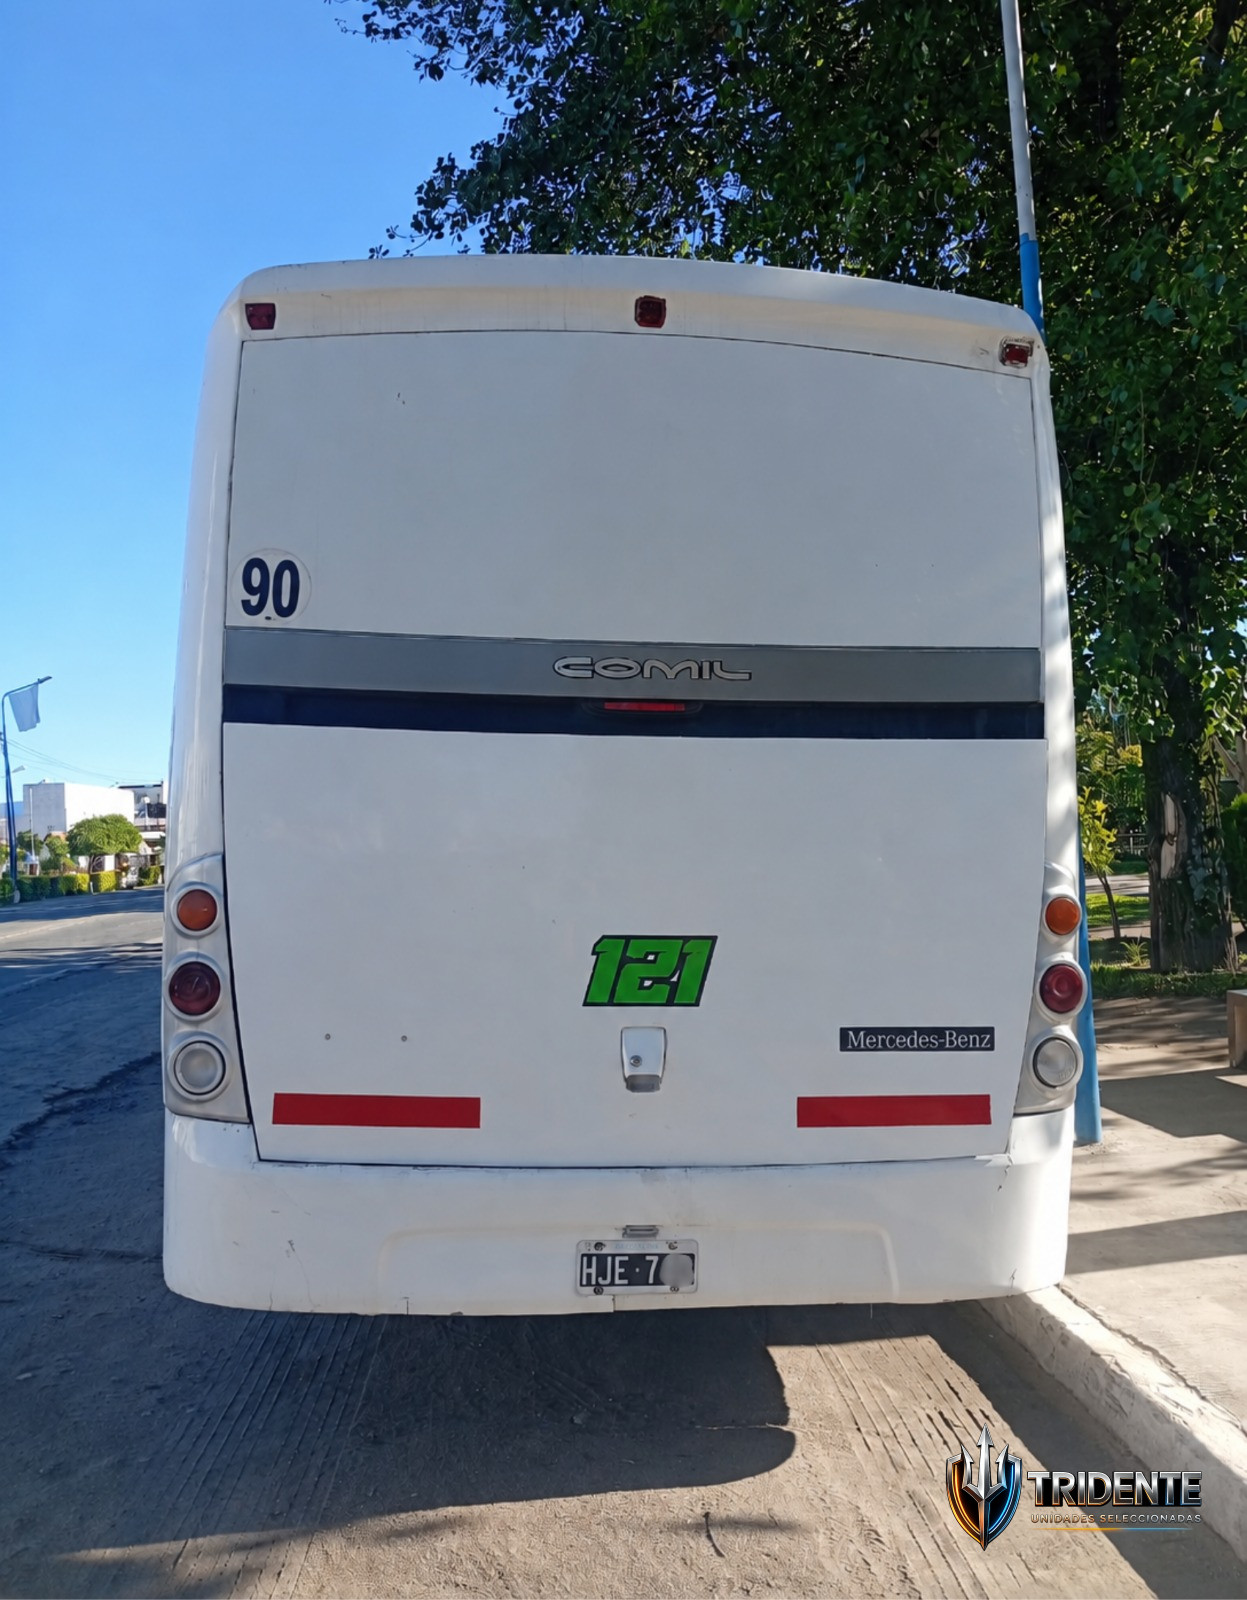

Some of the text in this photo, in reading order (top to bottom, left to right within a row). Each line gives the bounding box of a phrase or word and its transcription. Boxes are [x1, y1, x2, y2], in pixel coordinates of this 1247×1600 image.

[241, 557, 300, 618] 90
[553, 656, 752, 680] COMIL
[582, 935, 718, 1007] 121
[847, 1030, 991, 1049] Mercedes-Benz
